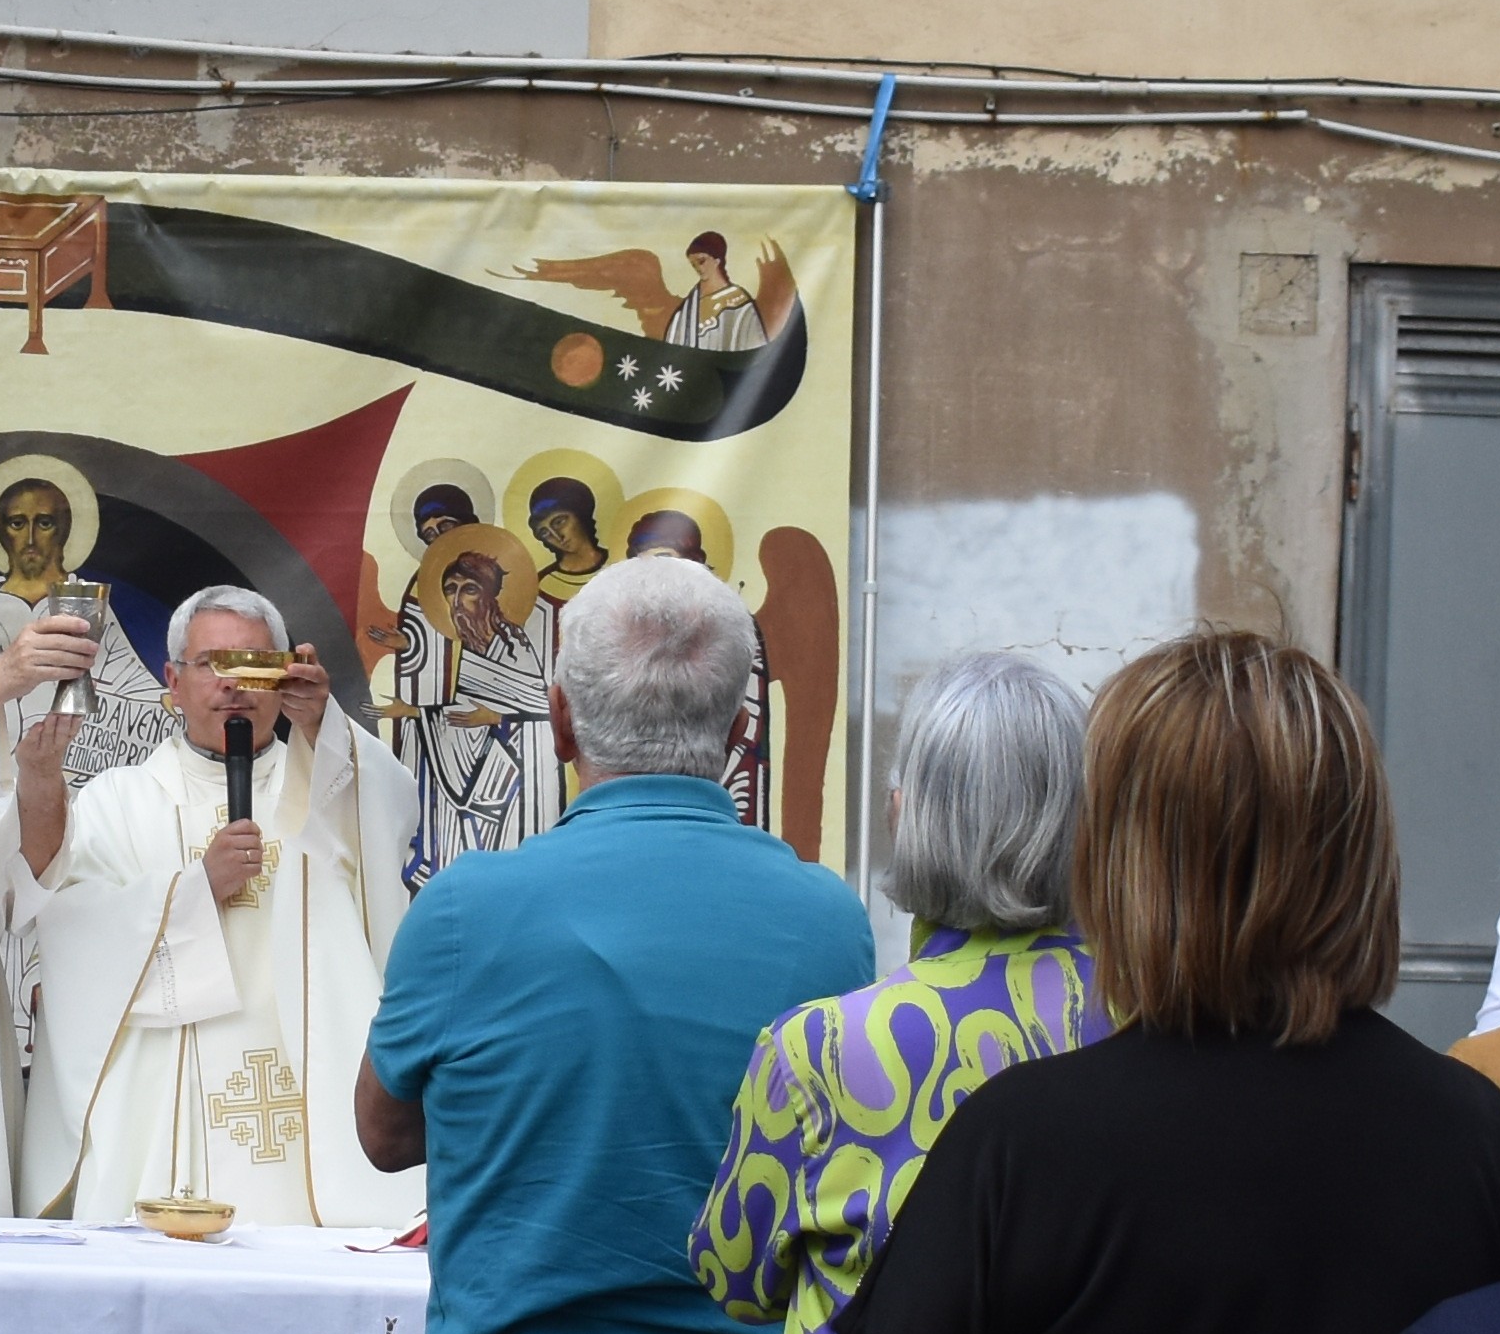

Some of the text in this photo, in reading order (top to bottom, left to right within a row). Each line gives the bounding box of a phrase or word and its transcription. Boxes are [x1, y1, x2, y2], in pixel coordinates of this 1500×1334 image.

[107, 700, 122, 730] A
[72, 723, 117, 752] STROS
[63, 744, 112, 773] EMIGOS
[114, 739, 154, 767] PRO
